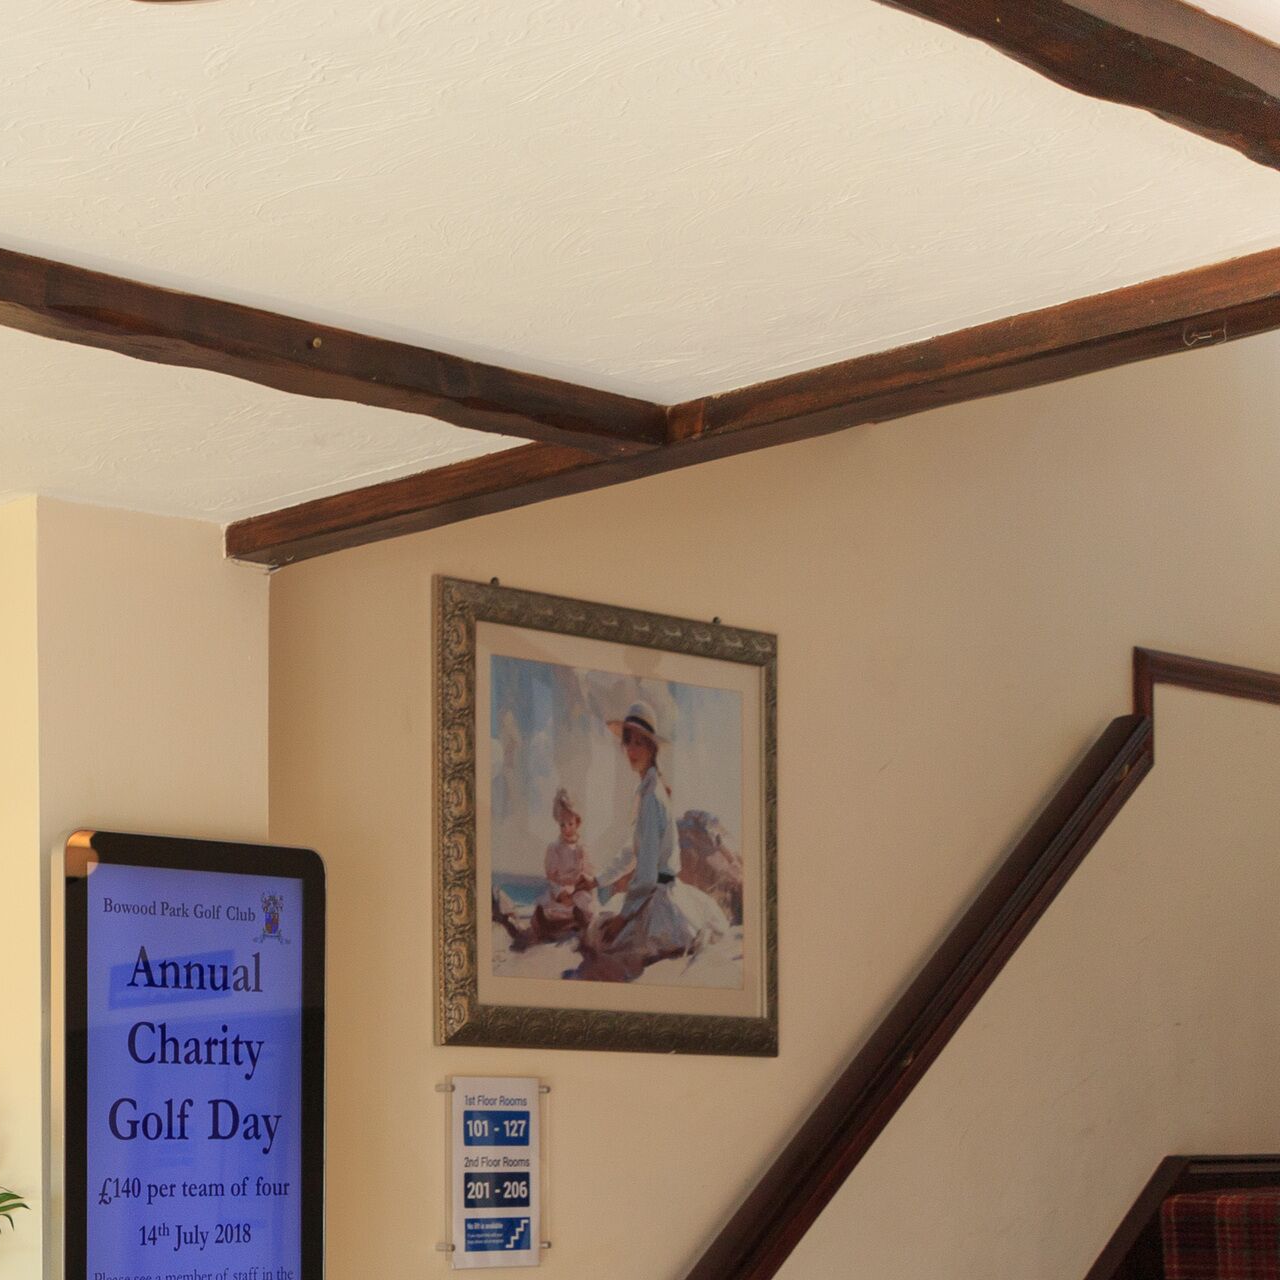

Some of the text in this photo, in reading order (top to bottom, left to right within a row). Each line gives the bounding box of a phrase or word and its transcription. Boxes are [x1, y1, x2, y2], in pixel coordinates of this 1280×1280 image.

[103, 898, 256, 922] Bowood Park Golf Club
[126, 945, 263, 993] Annual
[128, 1021, 264, 1080] Charity
[465, 1095, 527, 1106] 1st Floor Rooms
[108, 1097, 282, 1155] Golf Day
[467, 1120, 489, 1137] 101
[504, 1120, 526, 1137] 127
[464, 1157, 530, 1168] 2nd Floor Rooms
[98, 1176, 290, 1205] £140 per team of four
[467, 1182, 489, 1199] 201
[504, 1181, 528, 1198] 206
[140, 1223, 252, 1251] 14th July 2018
[262, 1267, 273, 1280] in
[276, 1266, 294, 1280] the
